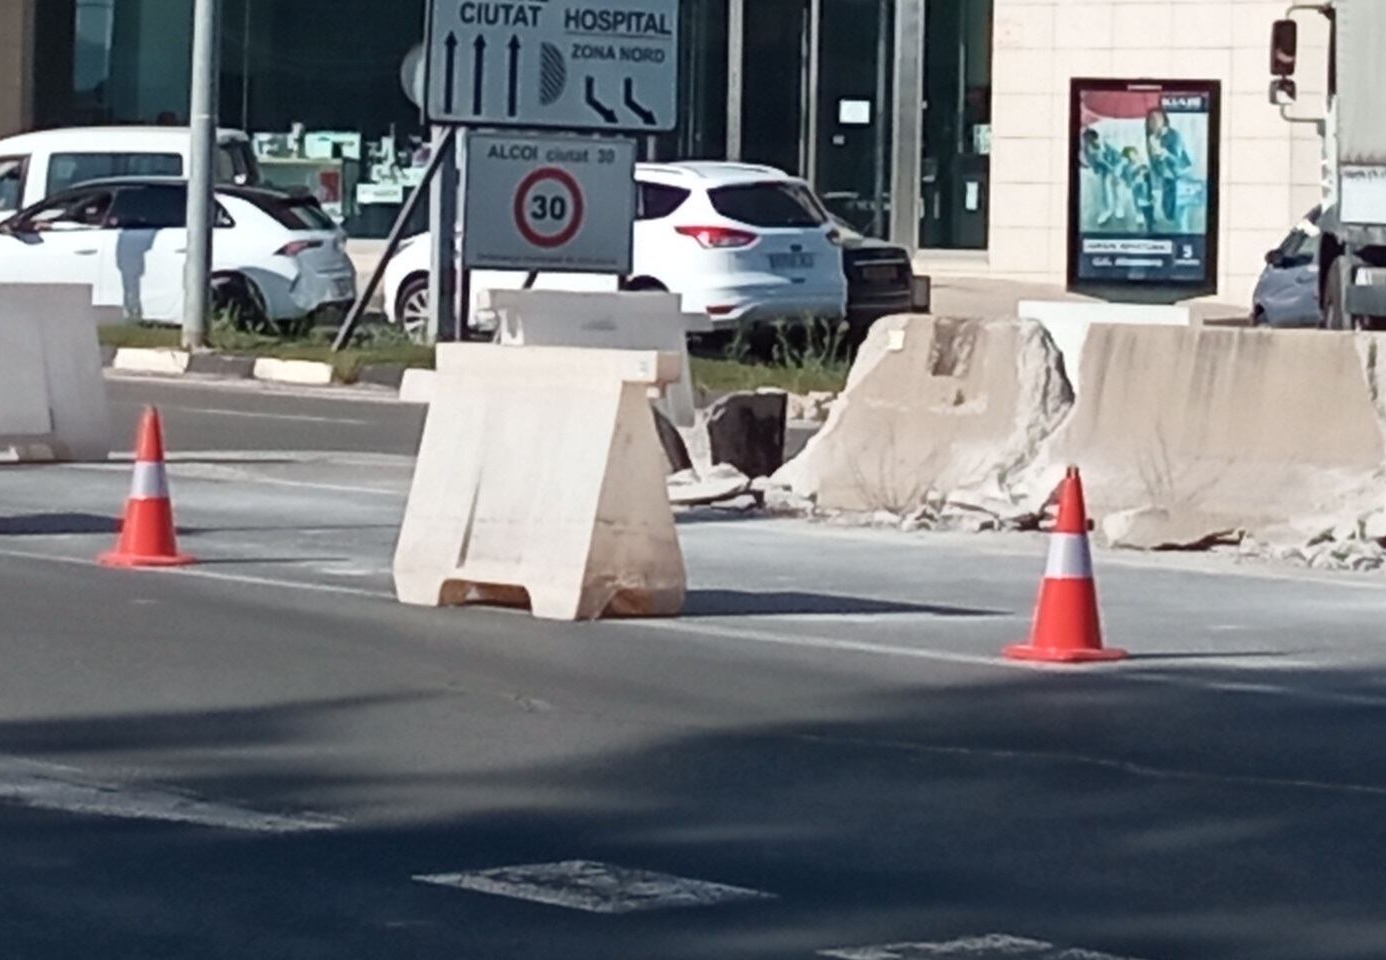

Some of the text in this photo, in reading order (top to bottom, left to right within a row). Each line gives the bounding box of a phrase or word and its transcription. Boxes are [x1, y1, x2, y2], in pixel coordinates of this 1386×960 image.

[460, 2, 542, 27] CIUTAT
[564, 8, 672, 35] HOSPITAL
[570, 43, 666, 64] ZONA NORD
[487, 144, 616, 164] ALCOI ciutat 30
[531, 195, 567, 221] 30
